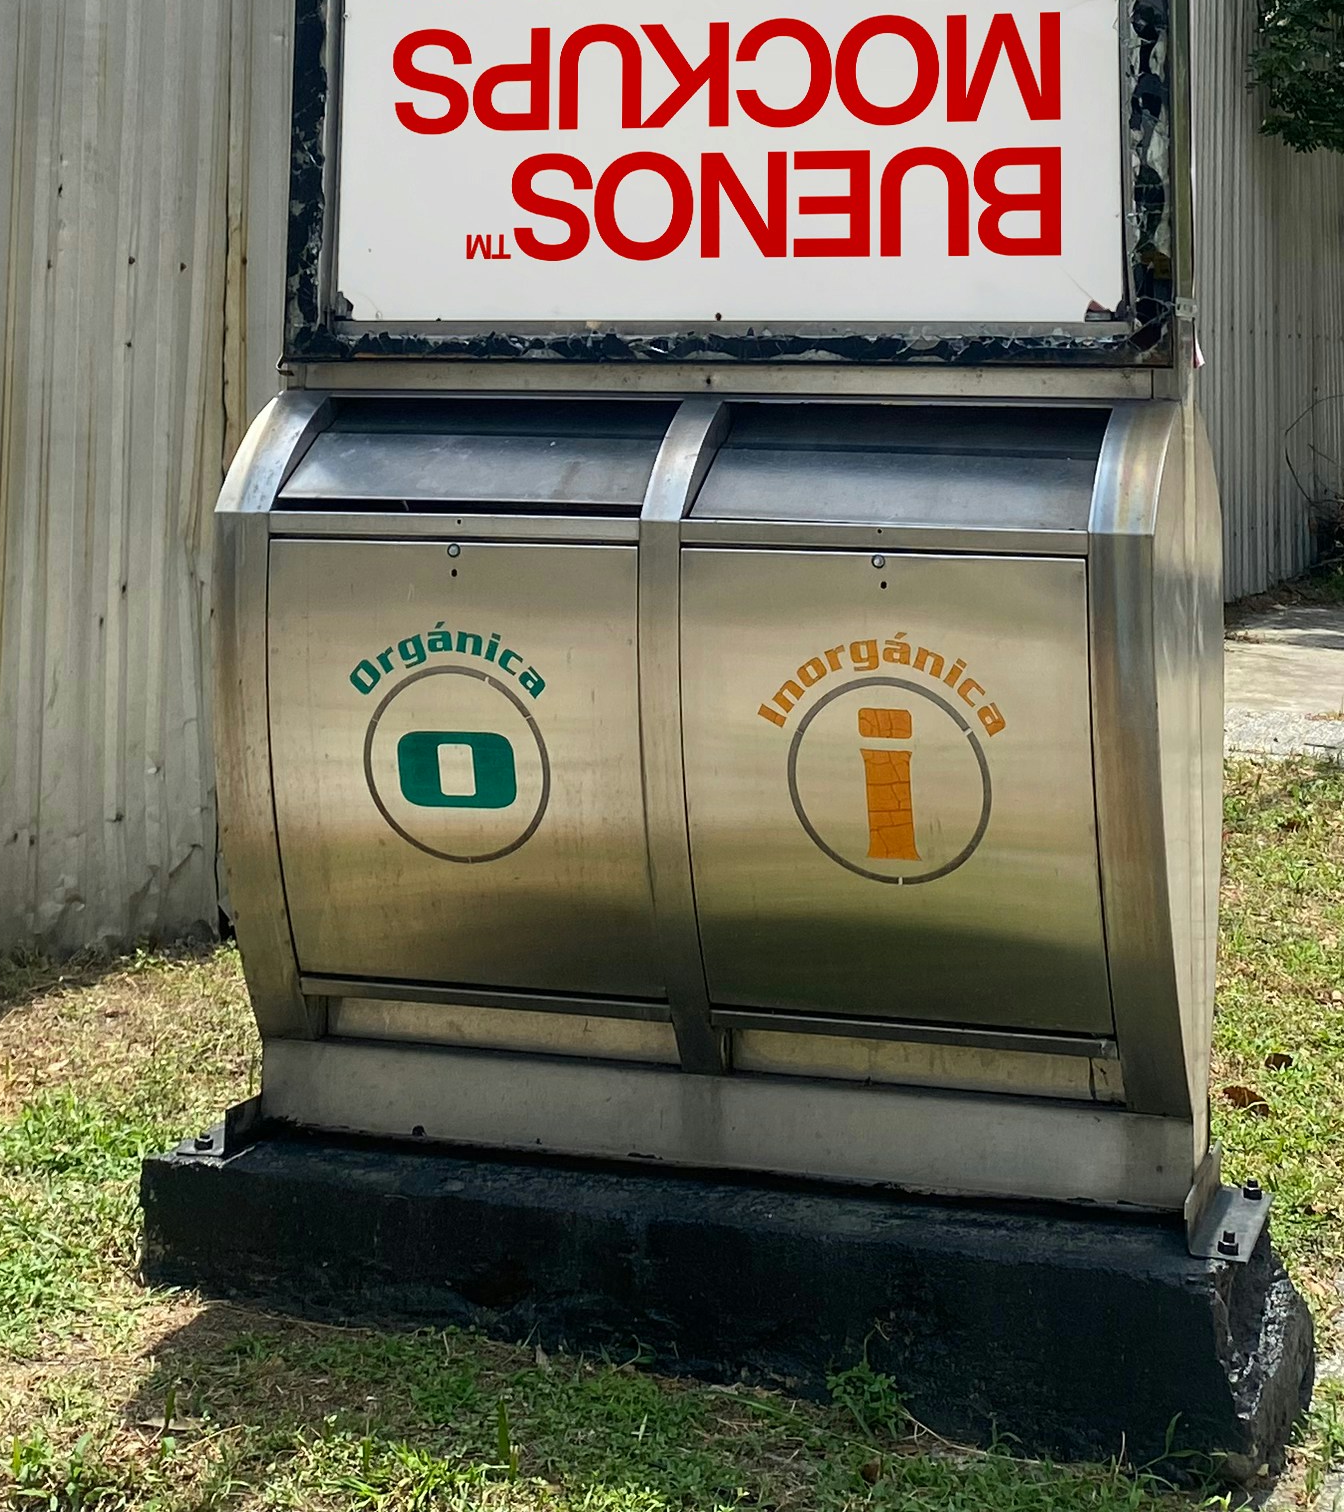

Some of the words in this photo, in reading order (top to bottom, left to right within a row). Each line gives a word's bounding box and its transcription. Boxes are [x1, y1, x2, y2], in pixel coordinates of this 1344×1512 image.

[393, 12, 1061, 134] MOCKUPS
[349, 621, 546, 700] Orgánica
[757, 631, 1007, 738] Inorgánica
